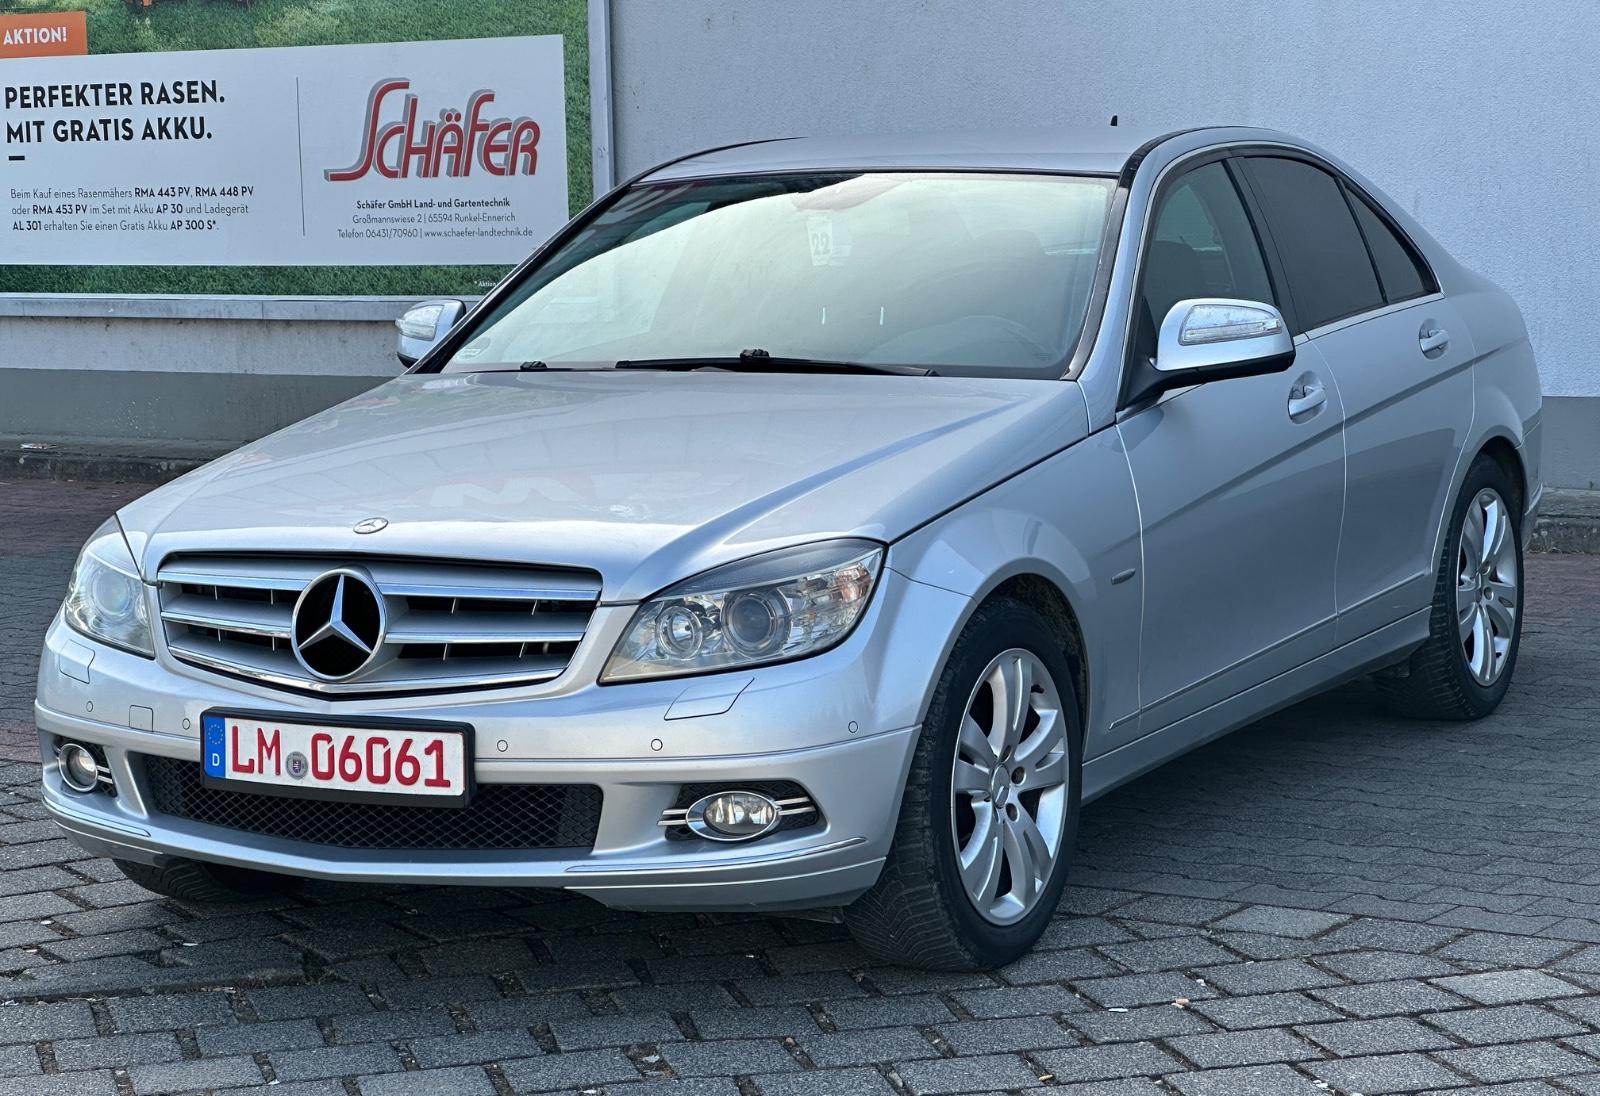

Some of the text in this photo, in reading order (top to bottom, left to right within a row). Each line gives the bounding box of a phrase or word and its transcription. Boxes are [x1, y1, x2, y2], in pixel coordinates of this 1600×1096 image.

[3, 27, 67, 45] AKTION!
[5, 80, 225, 109] PERFEKTER RASEN.
[7, 116, 212, 143] MIT GRATIS AKKU.
[10, 186, 254, 199] Beim Kauf eines Rasenmähers RMA 443 PV, RMA 448 PV
[11, 203, 249, 216] oder RMA 453 PV im Set mit Akku AP 30 und Ladegerät
[356, 197, 510, 209] Schäfer GmbH Land- und Gartentechnik
[352, 212, 516, 224] Großmannswiese 2 65594 Runkel-Ennerich
[12, 221, 25, 231] AL
[26, 221, 42, 231] 301
[43, 220, 78, 231] erhalten
[80, 220, 93, 231] Sie
[95, 220, 118, 231] einen
[120, 220, 145, 231] Gratis
[147, 220, 168, 231] Akku
[170, 220, 183, 231] AP
[185, 220, 205, 230] 300
[337, 227, 533, 238] Telefon 06431/70960 www.schaefer-landtechnik.de
[212, 753, 220, 767] D
[232, 725, 281, 776] LM
[311, 733, 451, 788] 06061
